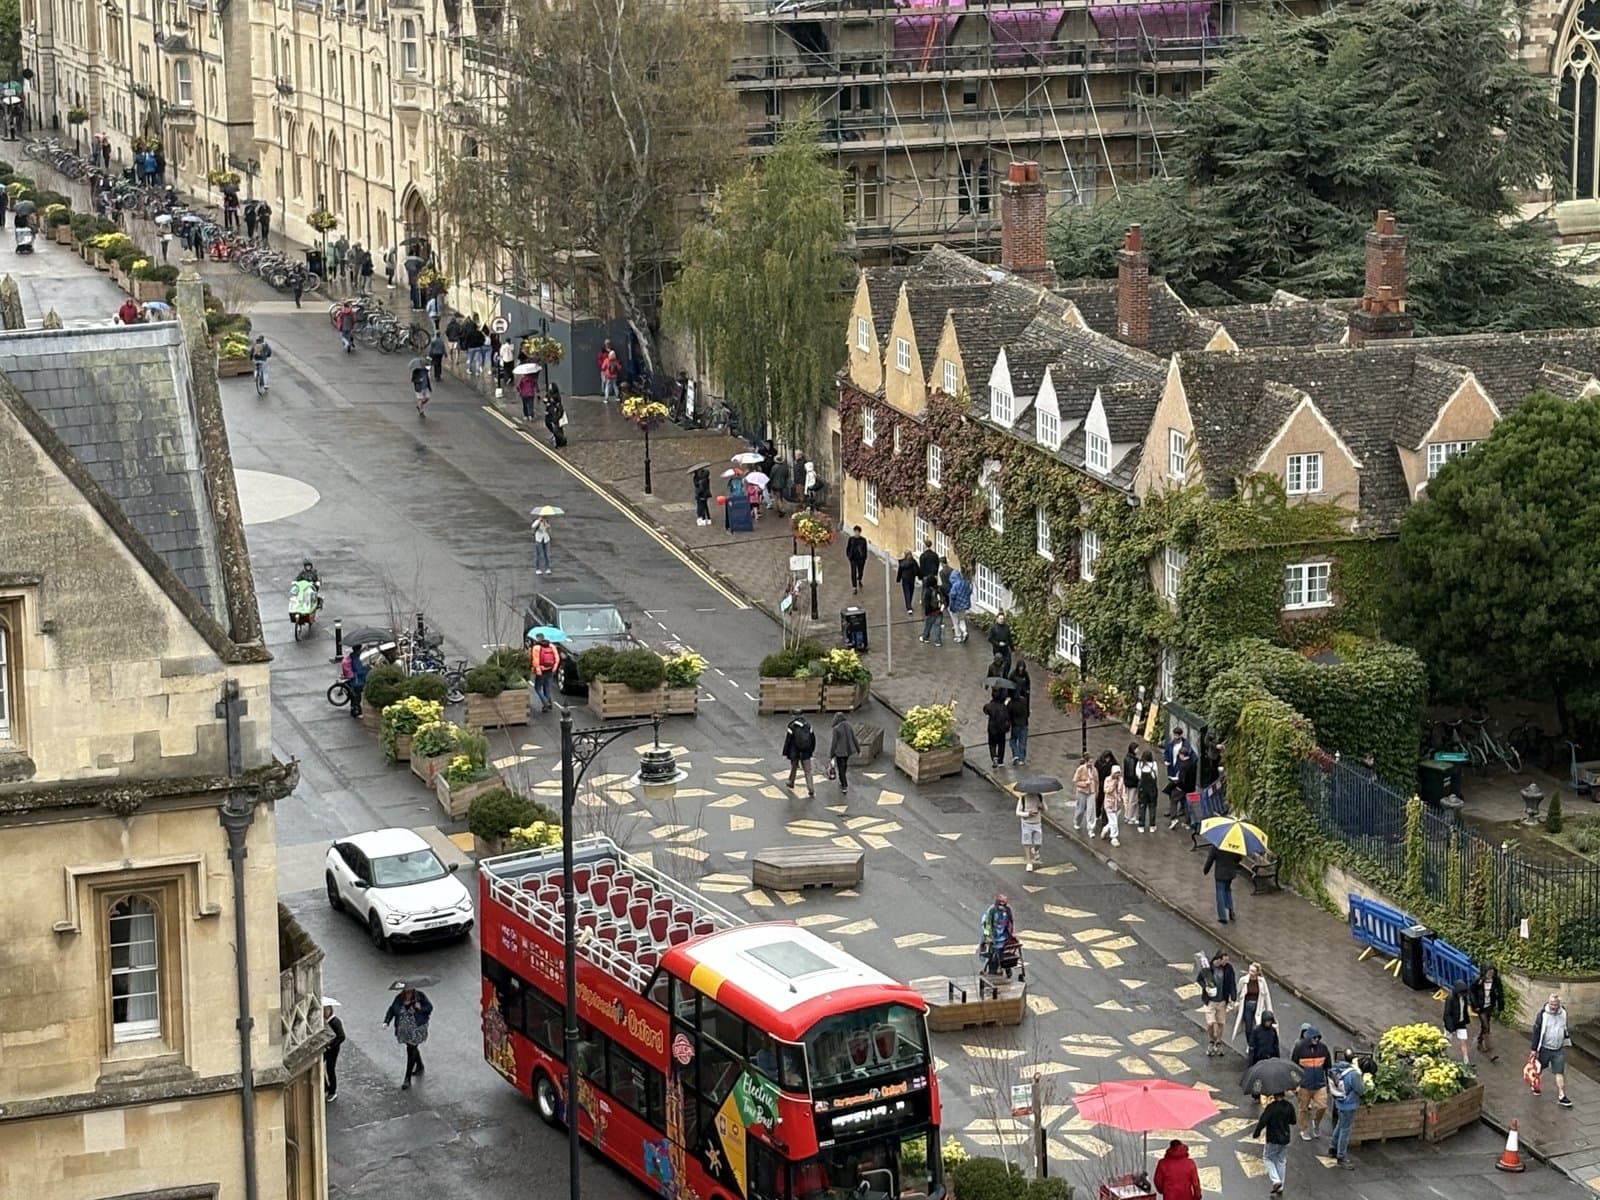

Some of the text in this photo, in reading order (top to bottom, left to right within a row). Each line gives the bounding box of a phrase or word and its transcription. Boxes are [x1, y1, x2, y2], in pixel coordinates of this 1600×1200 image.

[627, 1008, 664, 1055] Oxford
[742, 1071, 774, 1110] Electric
[881, 1080, 908, 1098] Oxford
